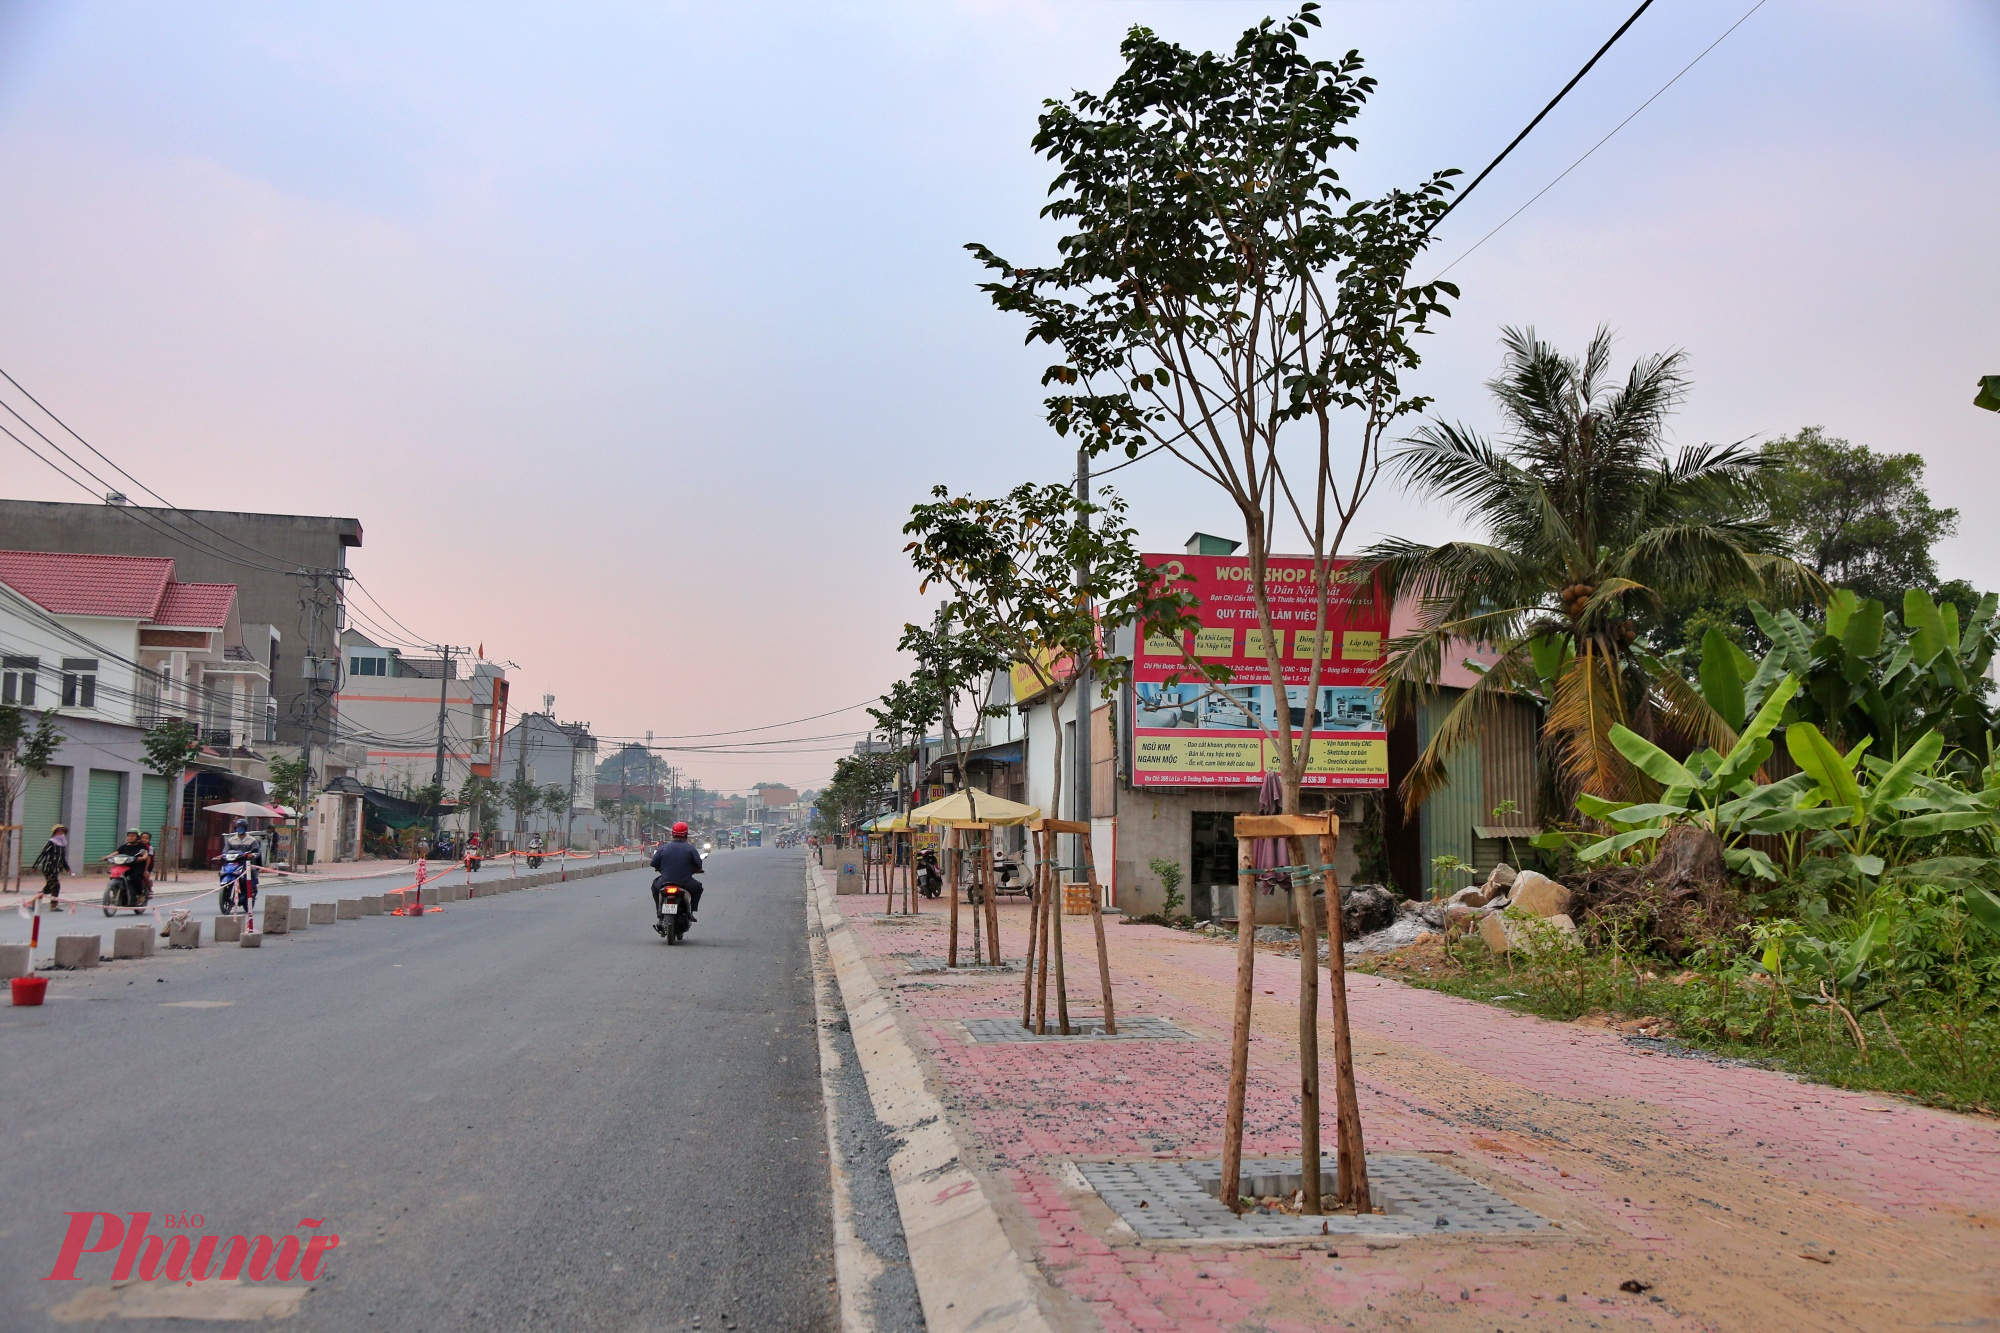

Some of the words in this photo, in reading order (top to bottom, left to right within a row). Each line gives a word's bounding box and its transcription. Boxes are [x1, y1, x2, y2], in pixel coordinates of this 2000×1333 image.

[1216, 566, 1306, 583] WORSHOP
[1273, 585, 1293, 594] Dân
[1296, 585, 1314, 598] Nội
[1217, 608, 1236, 619] QUY
[1271, 608, 1292, 620] LÀM
[1295, 609, 1317, 622] VIỆC
[1161, 756, 1177, 765] MỘC
